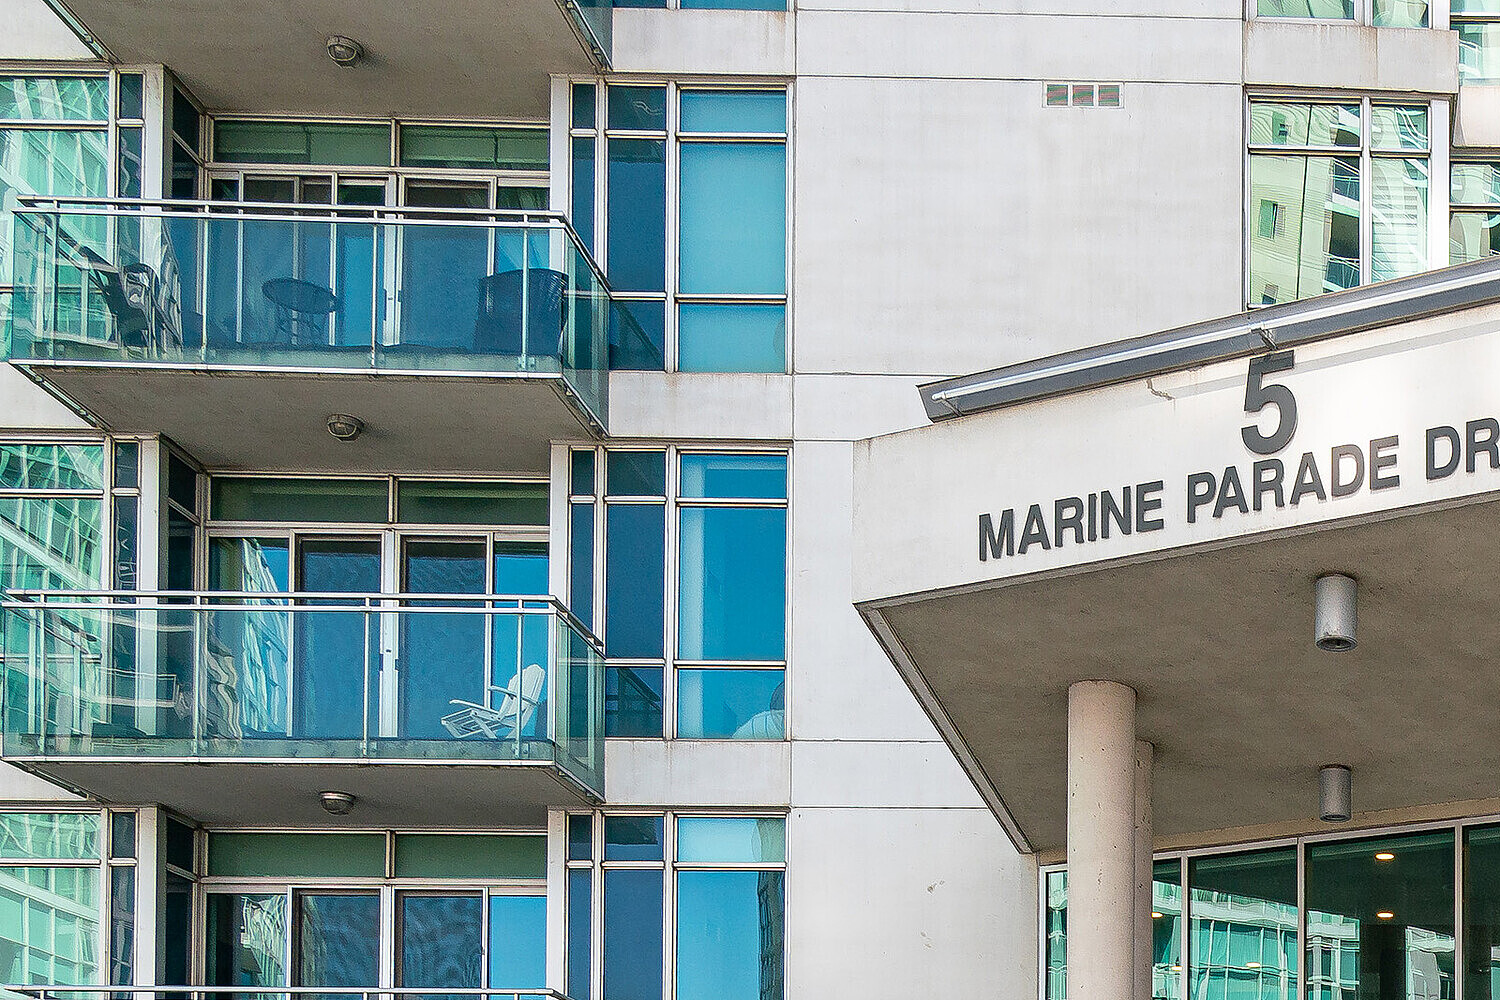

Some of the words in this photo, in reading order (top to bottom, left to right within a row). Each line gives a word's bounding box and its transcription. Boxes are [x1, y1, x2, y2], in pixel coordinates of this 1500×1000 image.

[1241, 350, 1298, 455] 5
[979, 480, 1165, 562] MARINE
[1187, 435, 1400, 523] PARADE
